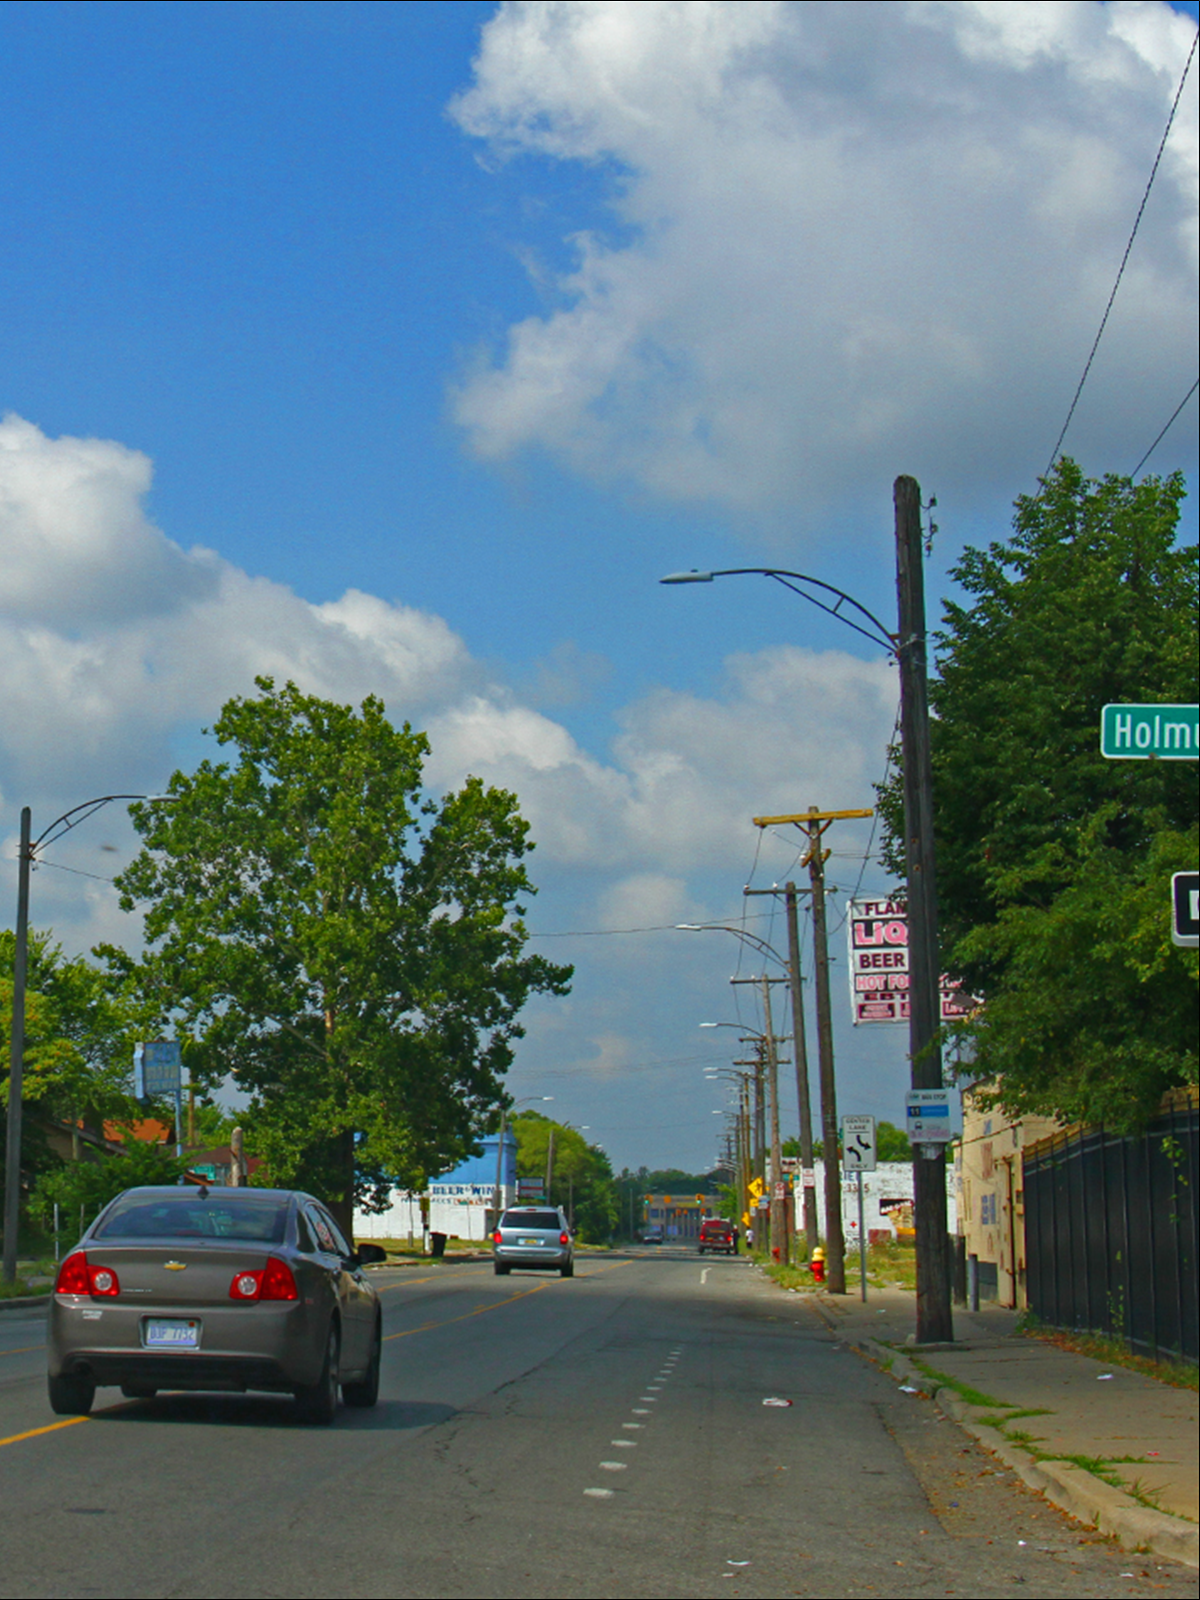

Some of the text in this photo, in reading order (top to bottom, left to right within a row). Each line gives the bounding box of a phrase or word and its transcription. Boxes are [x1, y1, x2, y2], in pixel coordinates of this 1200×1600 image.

[1114, 713, 1199, 748] Holm
[854, 921, 908, 946] LIQ
[860, 952, 905, 968] BEER
[856, 973, 910, 991] HOT FO
[432, 1185, 464, 1195] BEER
[471, 1185, 496, 1196] WIN
